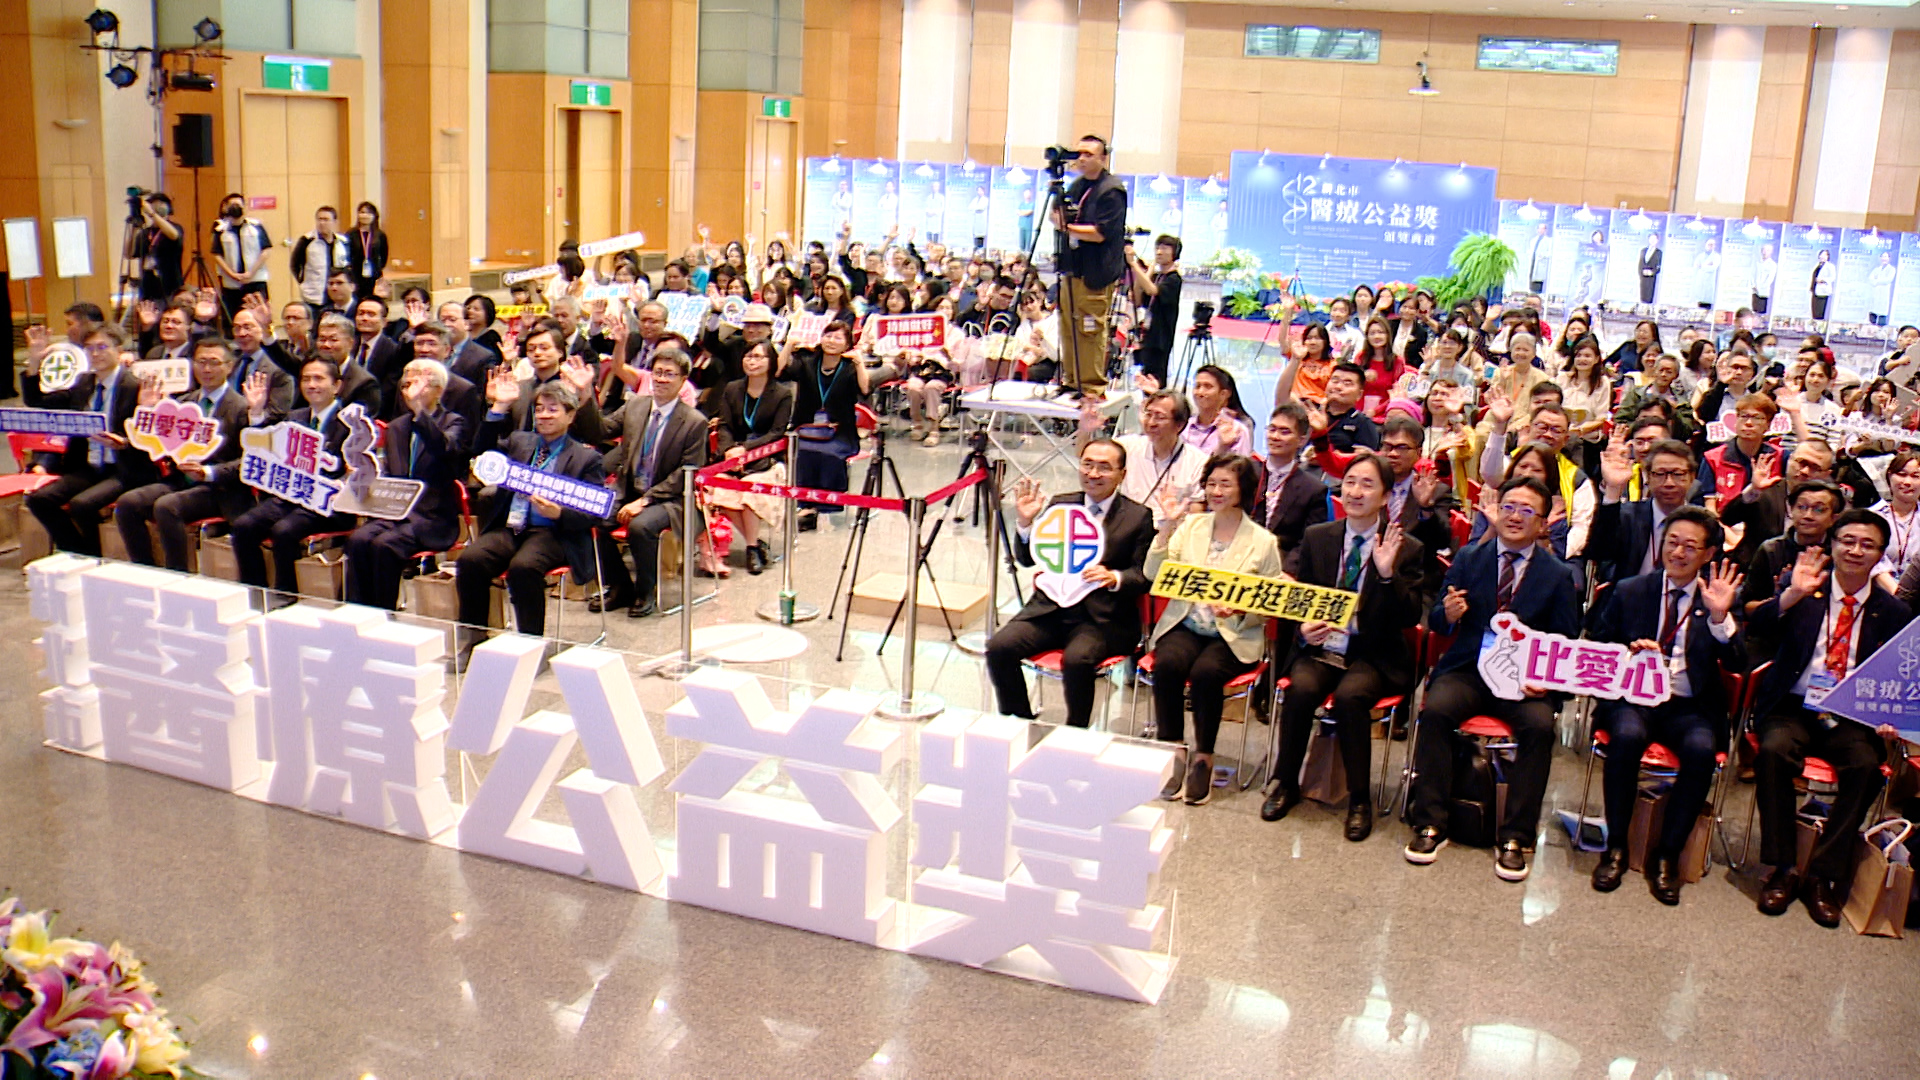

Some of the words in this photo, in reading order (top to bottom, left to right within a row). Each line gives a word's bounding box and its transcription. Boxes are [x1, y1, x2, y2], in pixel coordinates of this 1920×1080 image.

[1310, 197, 1439, 230] 醫療公益獎
[134, 410, 216, 445] 用愛守護
[243, 454, 340, 512] 我得獎了
[1159, 567, 1353, 625] #侯sir挺醫護
[1525, 638, 1665, 700] 比愛心
[80, 563, 1180, 1004] 醫療公益獎
